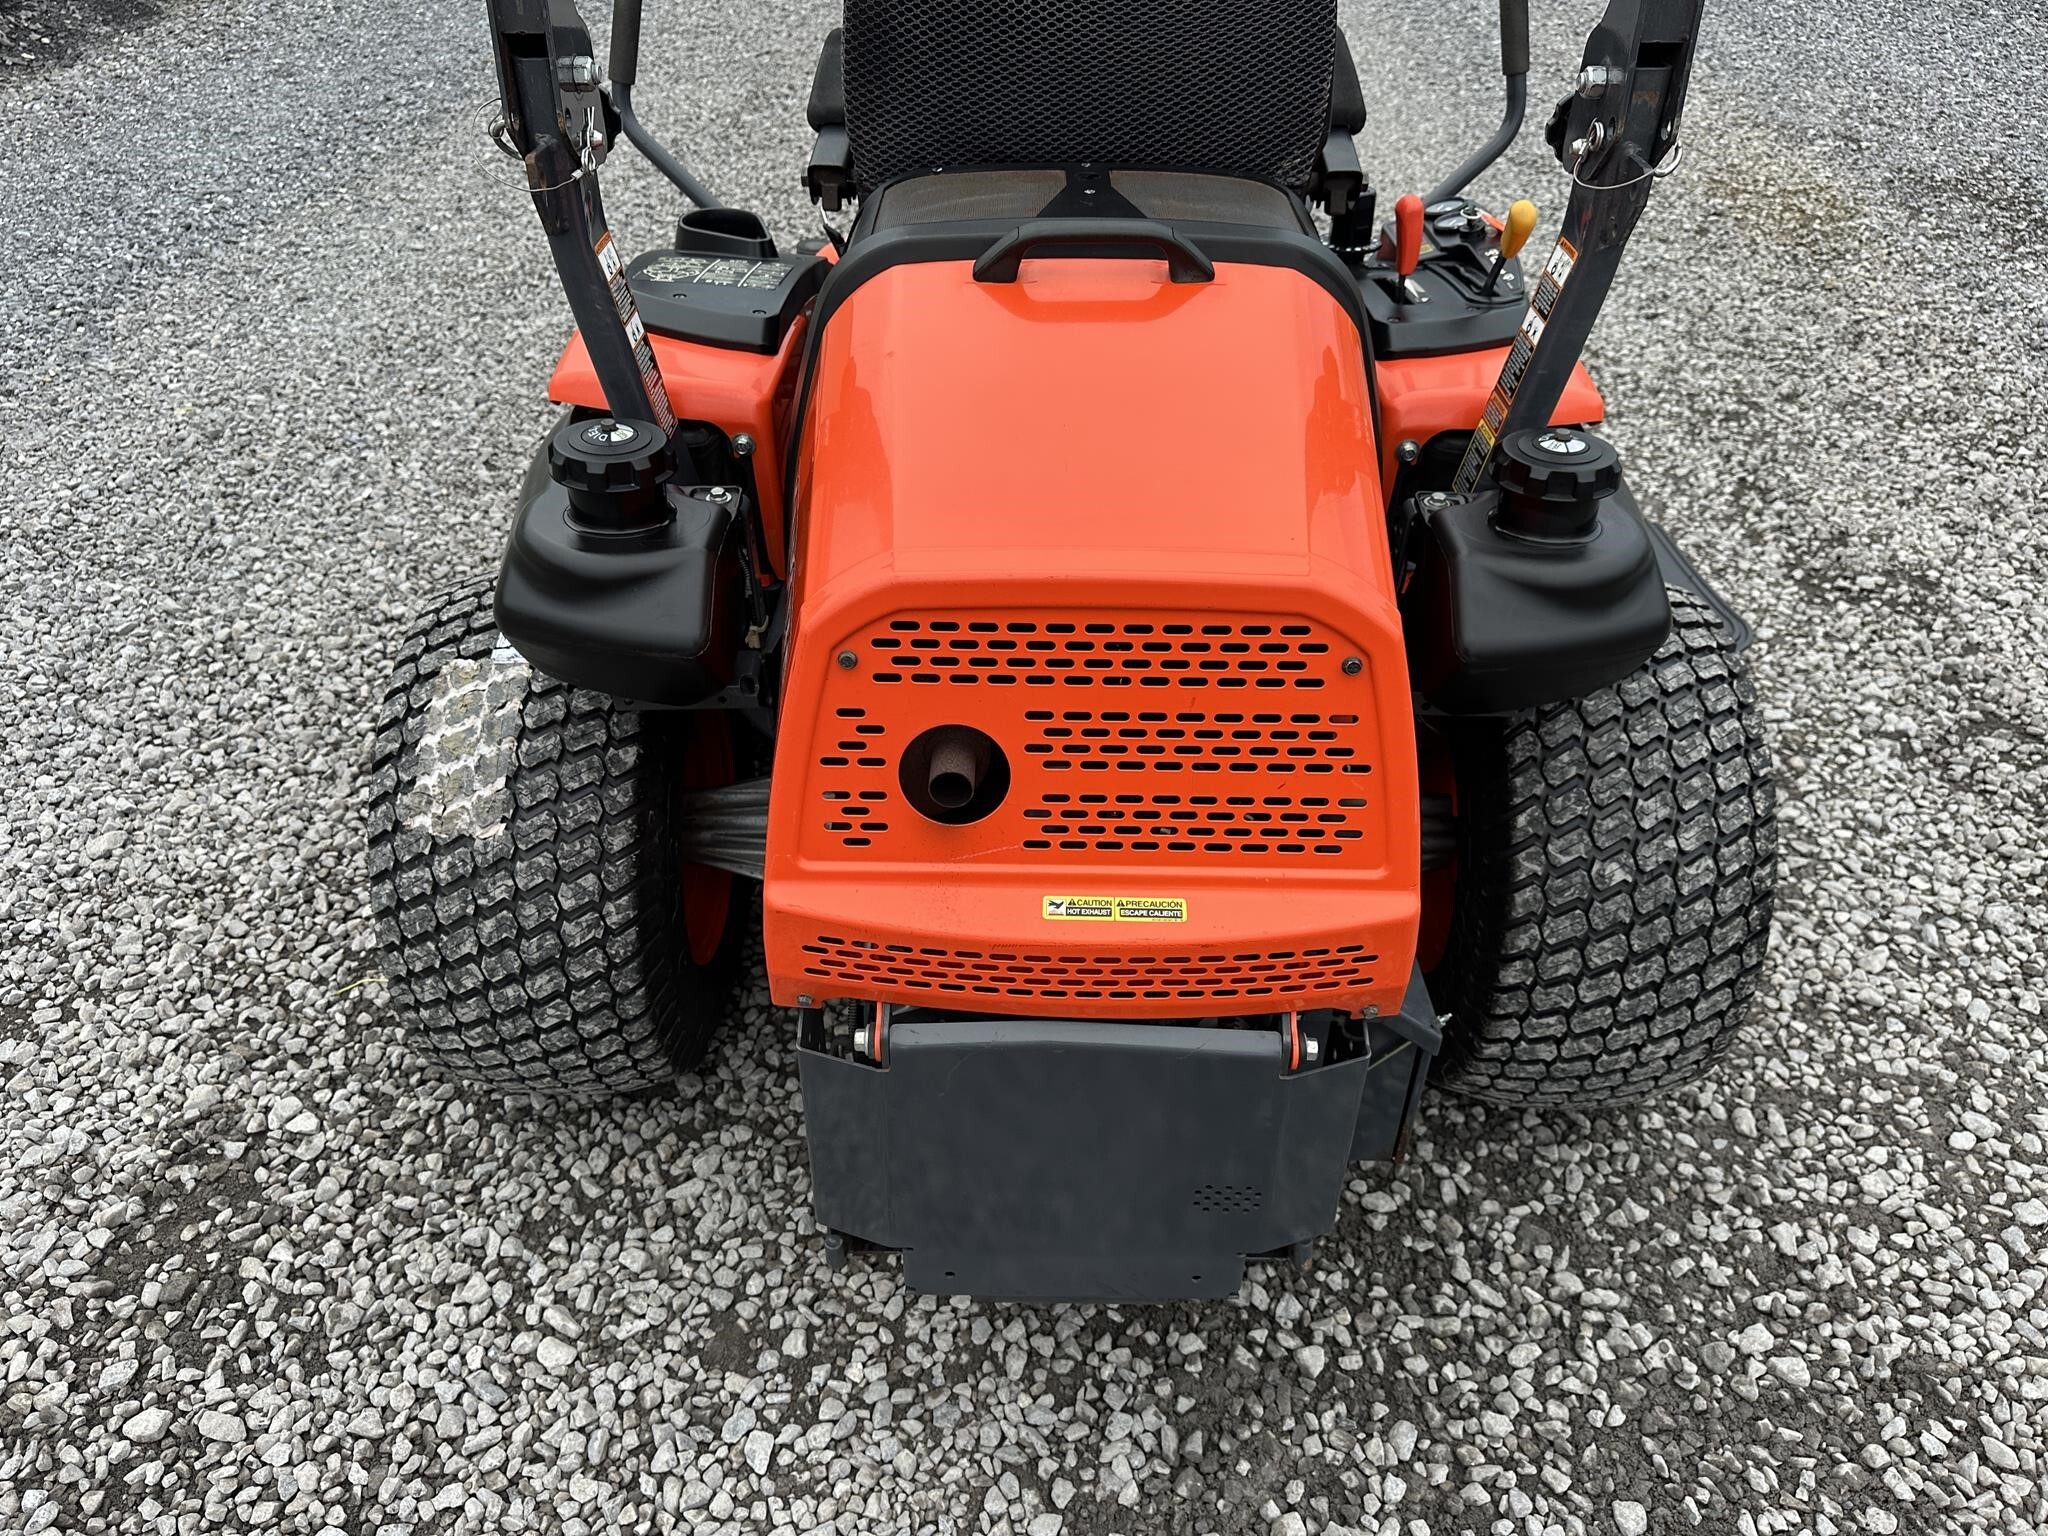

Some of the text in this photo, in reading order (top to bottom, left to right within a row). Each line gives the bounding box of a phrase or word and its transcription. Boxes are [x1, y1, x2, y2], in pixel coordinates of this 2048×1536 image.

[1076, 899, 1112, 907] CAUTION
[1125, 900, 1182, 908] PRECAUCIÓN
[1081, 908, 1111, 916] EXHAUST
[1120, 909, 1182, 917] ESCAPE CALIENTE
